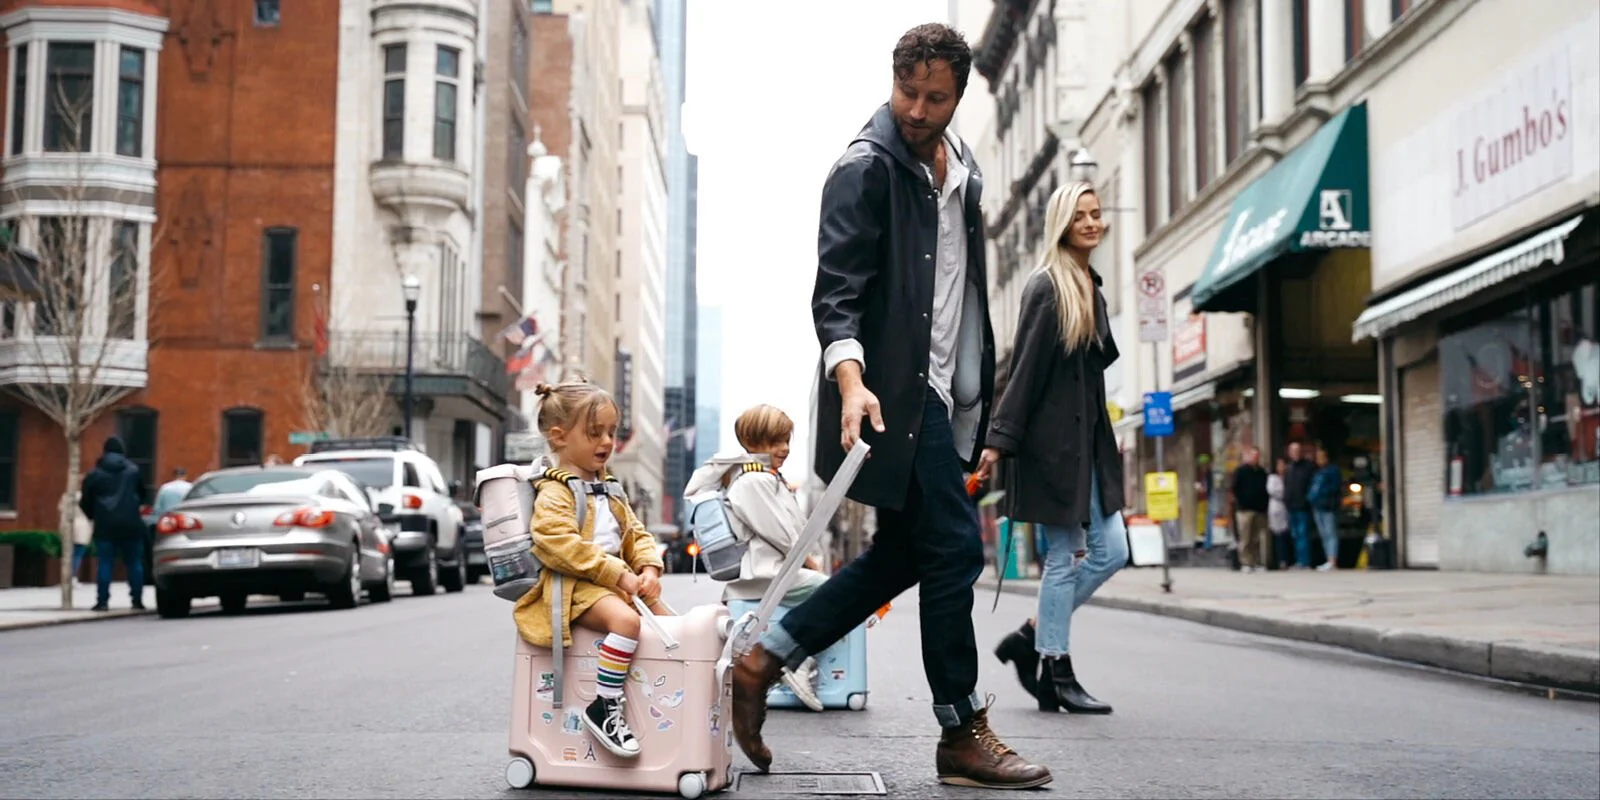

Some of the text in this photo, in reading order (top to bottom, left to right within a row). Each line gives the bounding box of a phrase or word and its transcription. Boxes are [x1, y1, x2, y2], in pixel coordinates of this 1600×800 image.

[1473, 88, 1567, 184] Gumbo's
[1320, 189, 1352, 229] A
[1299, 230, 1372, 248] ARCADE
